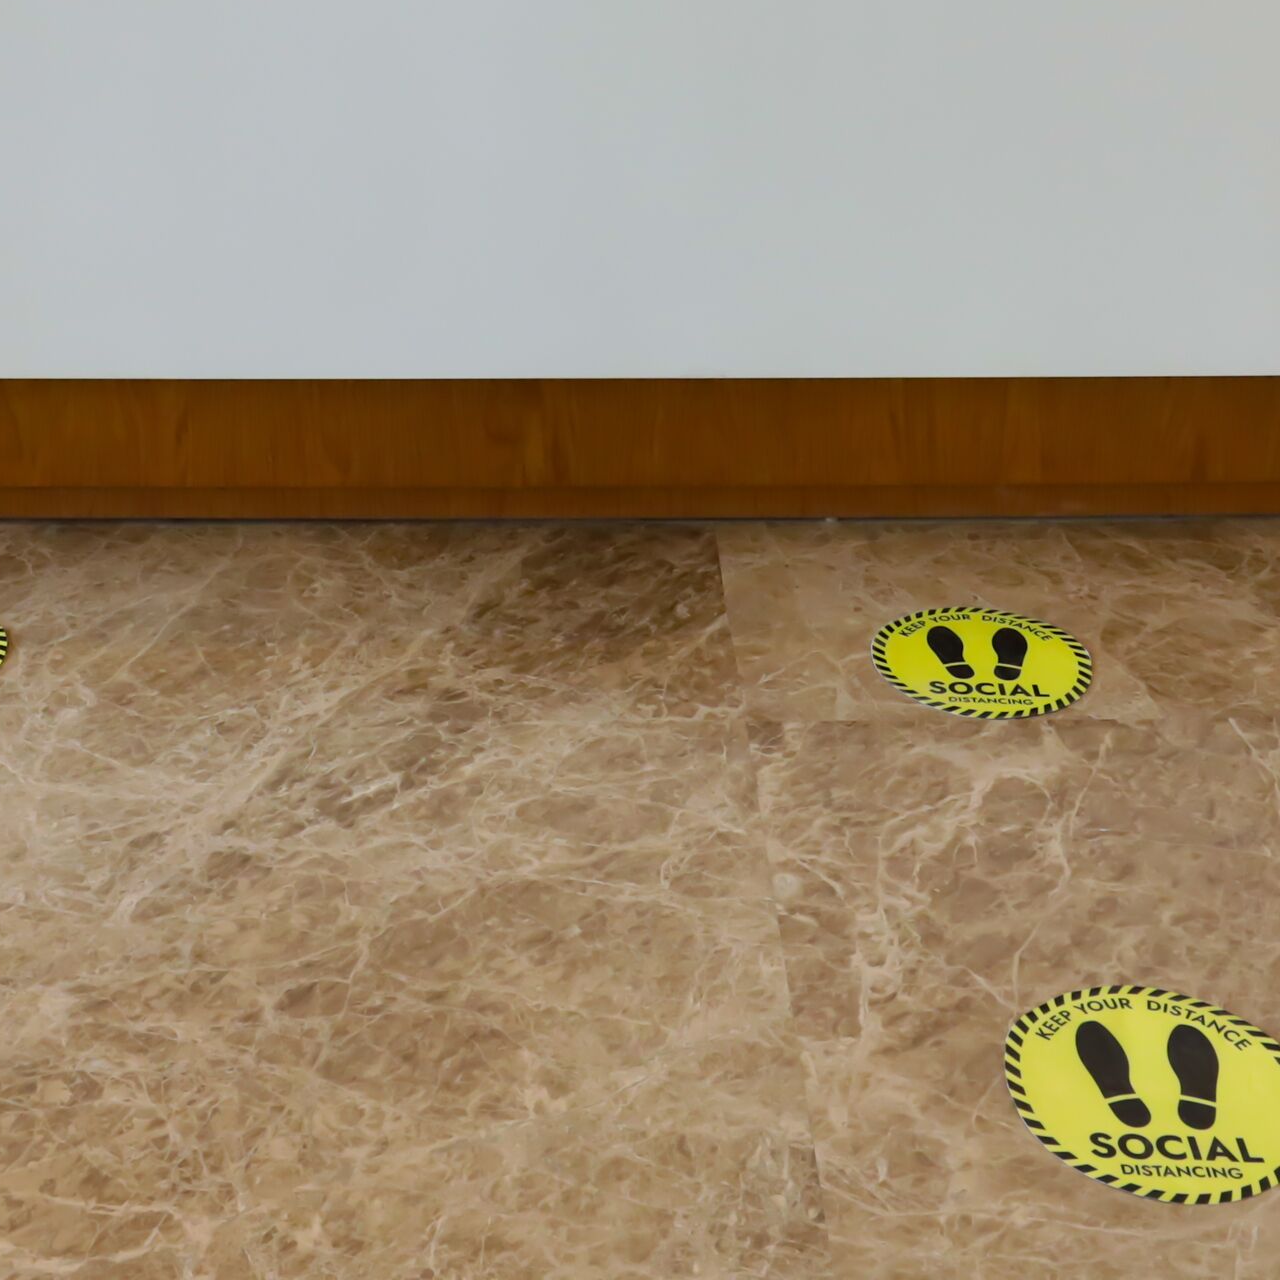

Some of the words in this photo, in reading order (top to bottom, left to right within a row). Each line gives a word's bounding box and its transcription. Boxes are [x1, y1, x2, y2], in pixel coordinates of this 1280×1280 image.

[899, 620, 926, 638] KEEP
[928, 614, 971, 624] YOUR
[981, 614, 1054, 642] DISTANCE
[929, 680, 1050, 698] SOCIAL
[948, 696, 1034, 706] DISTANCING
[1034, 1010, 1073, 1040] KEEP
[1073, 998, 1133, 1015] YOUR
[1146, 1000, 1252, 1051] DISTANCE
[1089, 1132, 1265, 1164] SOCIAL
[1120, 1164, 1244, 1180] DISTANCING
